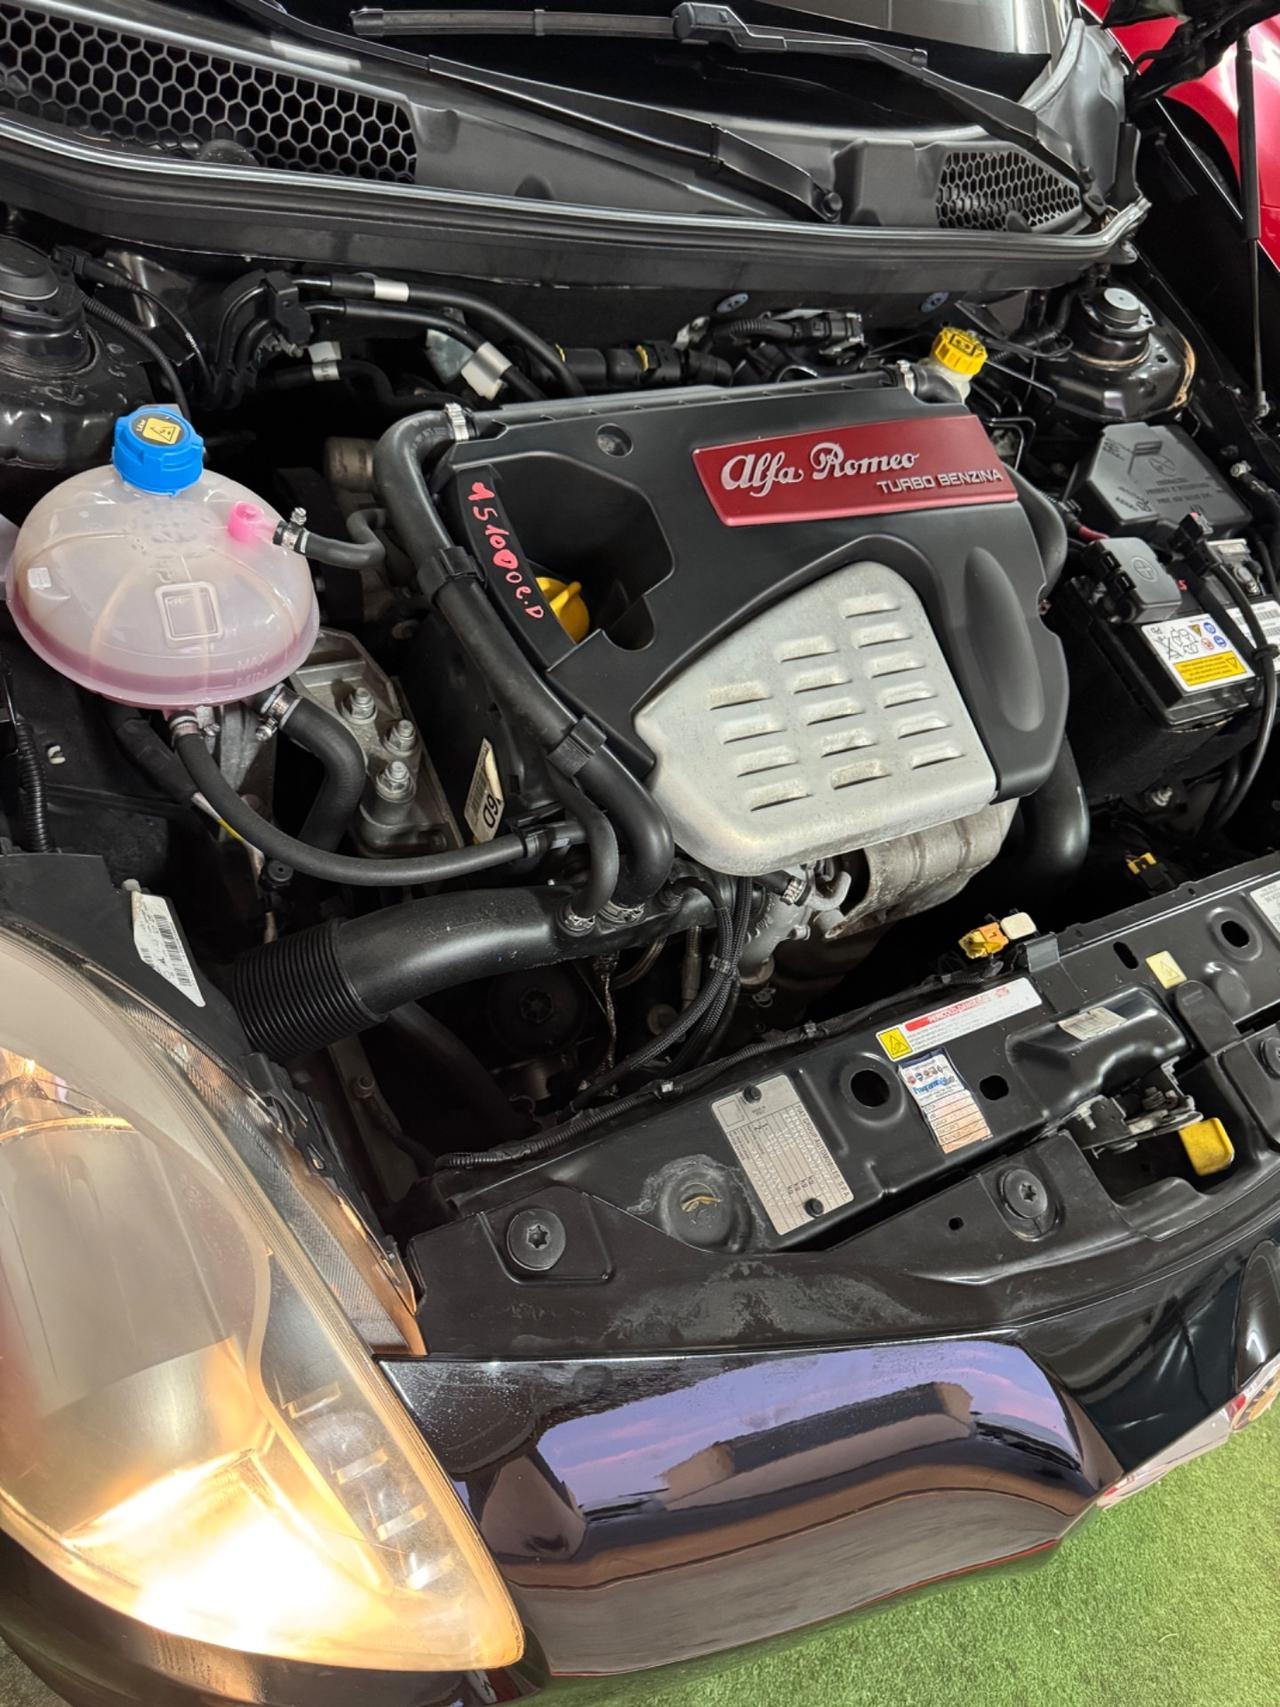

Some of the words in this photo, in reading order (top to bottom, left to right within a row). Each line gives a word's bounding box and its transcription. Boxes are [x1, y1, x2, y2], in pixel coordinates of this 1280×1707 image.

[721, 452, 804, 497] Alfa
[810, 442, 919, 481] Romeo
[876, 475, 936, 494] TURBO
[937, 468, 1004, 487] BENZINA
